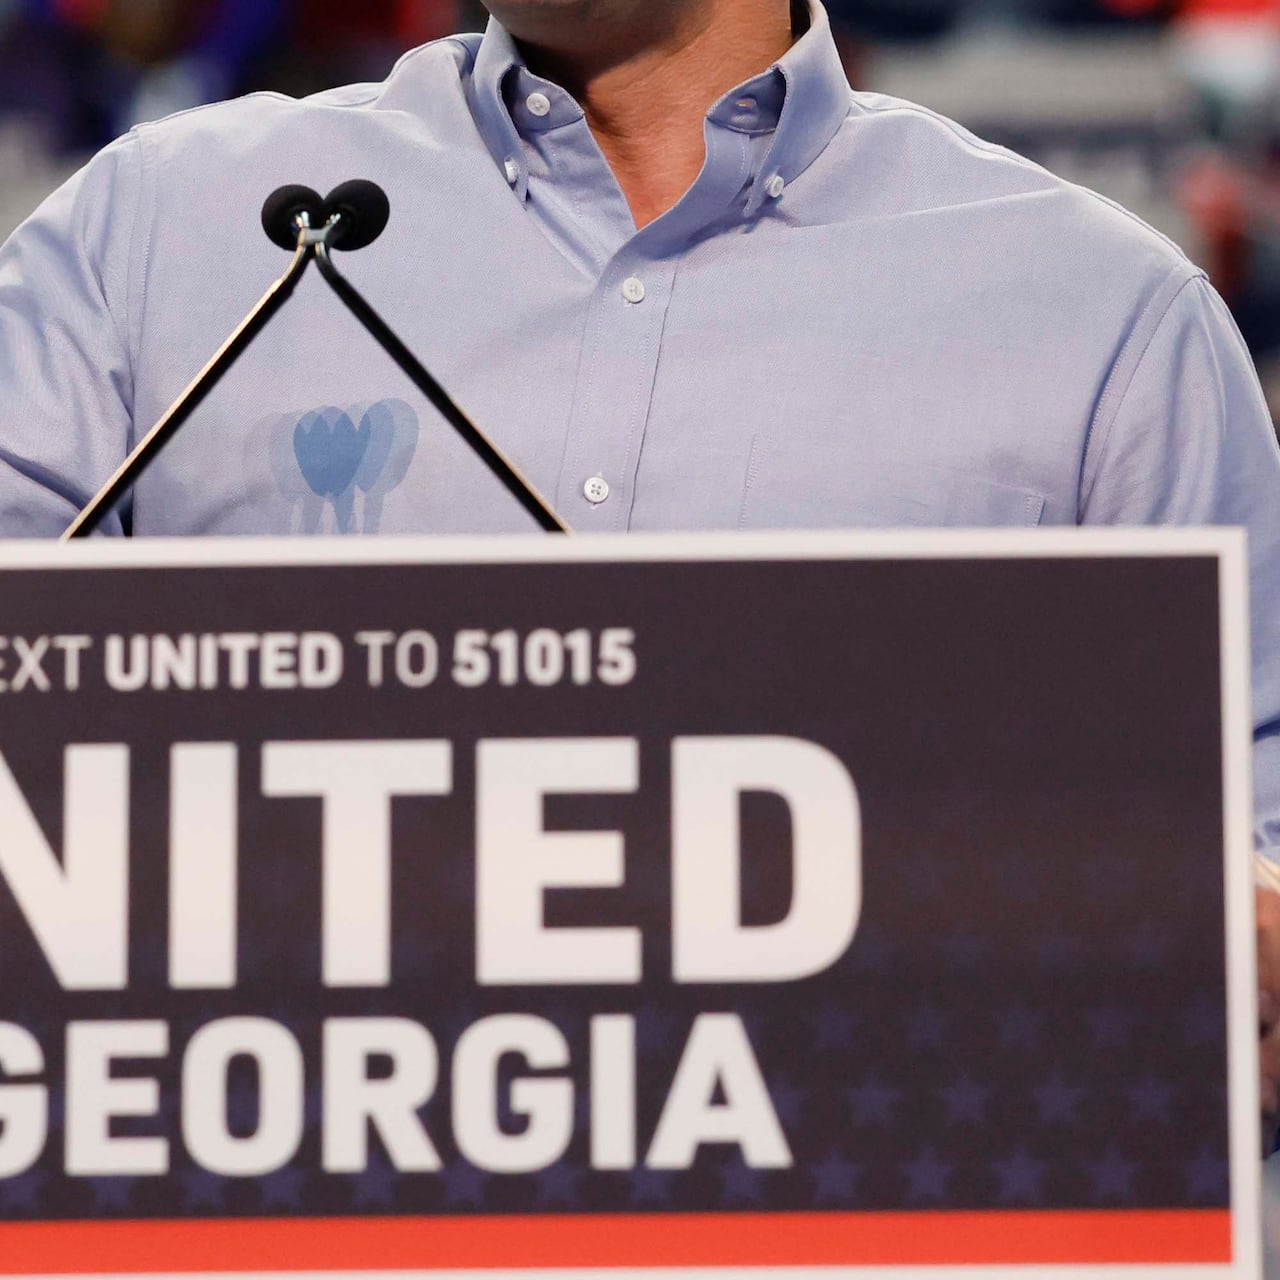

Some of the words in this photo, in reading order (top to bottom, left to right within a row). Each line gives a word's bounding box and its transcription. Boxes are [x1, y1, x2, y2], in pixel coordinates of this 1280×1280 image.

[104, 630, 344, 690] UNITED
[356, 630, 439, 686] TO
[451, 627, 637, 686] 51015
